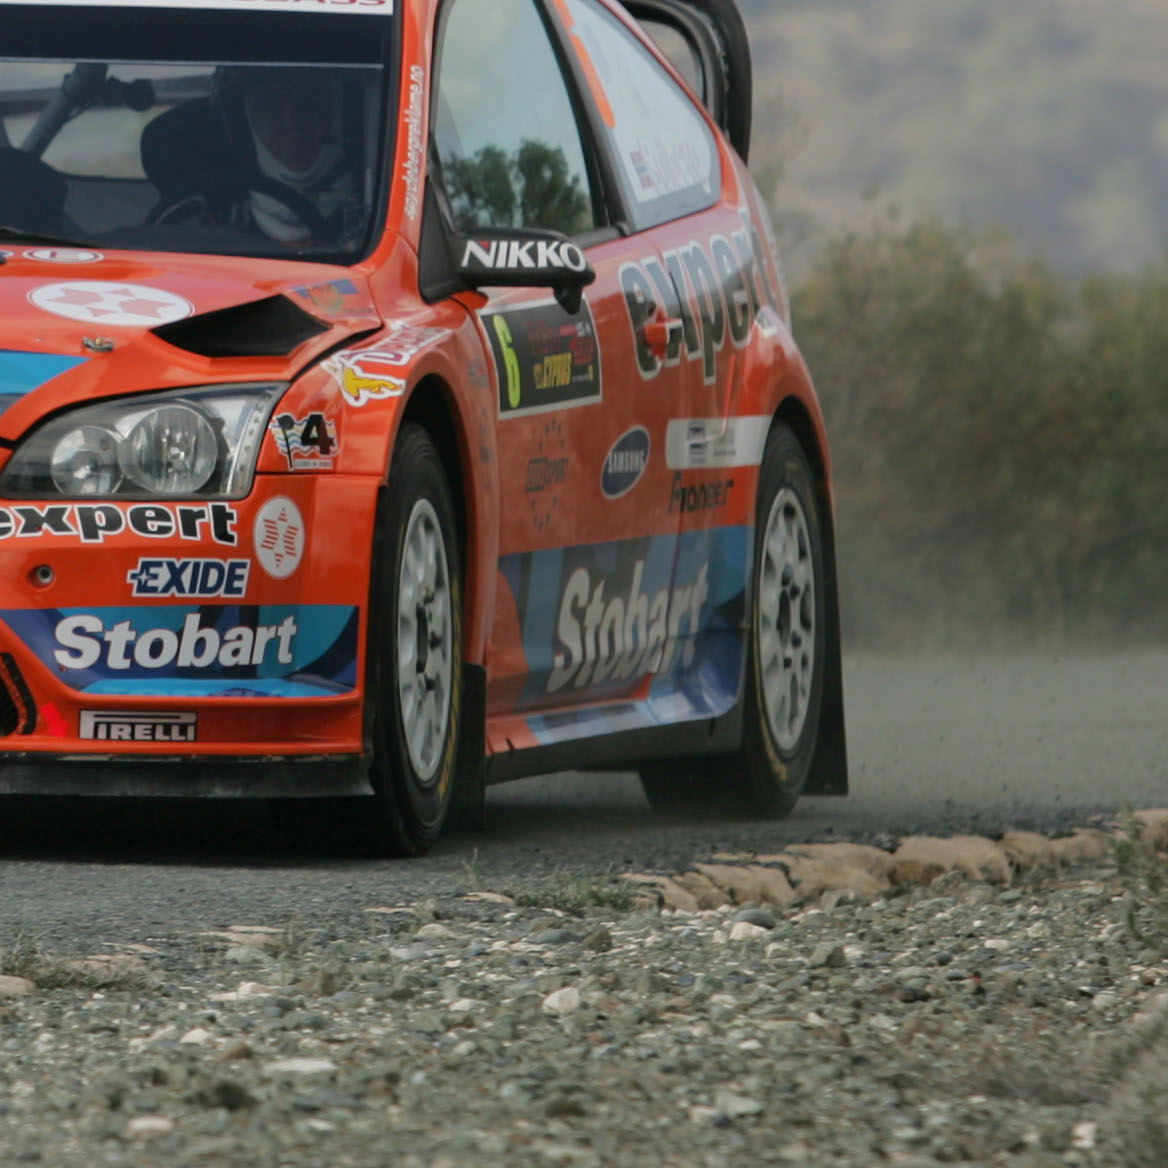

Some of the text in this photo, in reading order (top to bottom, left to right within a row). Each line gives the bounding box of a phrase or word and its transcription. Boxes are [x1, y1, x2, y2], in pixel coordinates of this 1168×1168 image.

[462, 240, 586, 272] NIKKO
[493, 314, 520, 408] 6
[608, 449, 646, 474] SAMSUNG
[133, 560, 249, 595] EXIDE
[53, 613, 297, 670] Stobart
[544, 559, 708, 693] Stobart
[81, 712, 197, 740] PIRELLI
